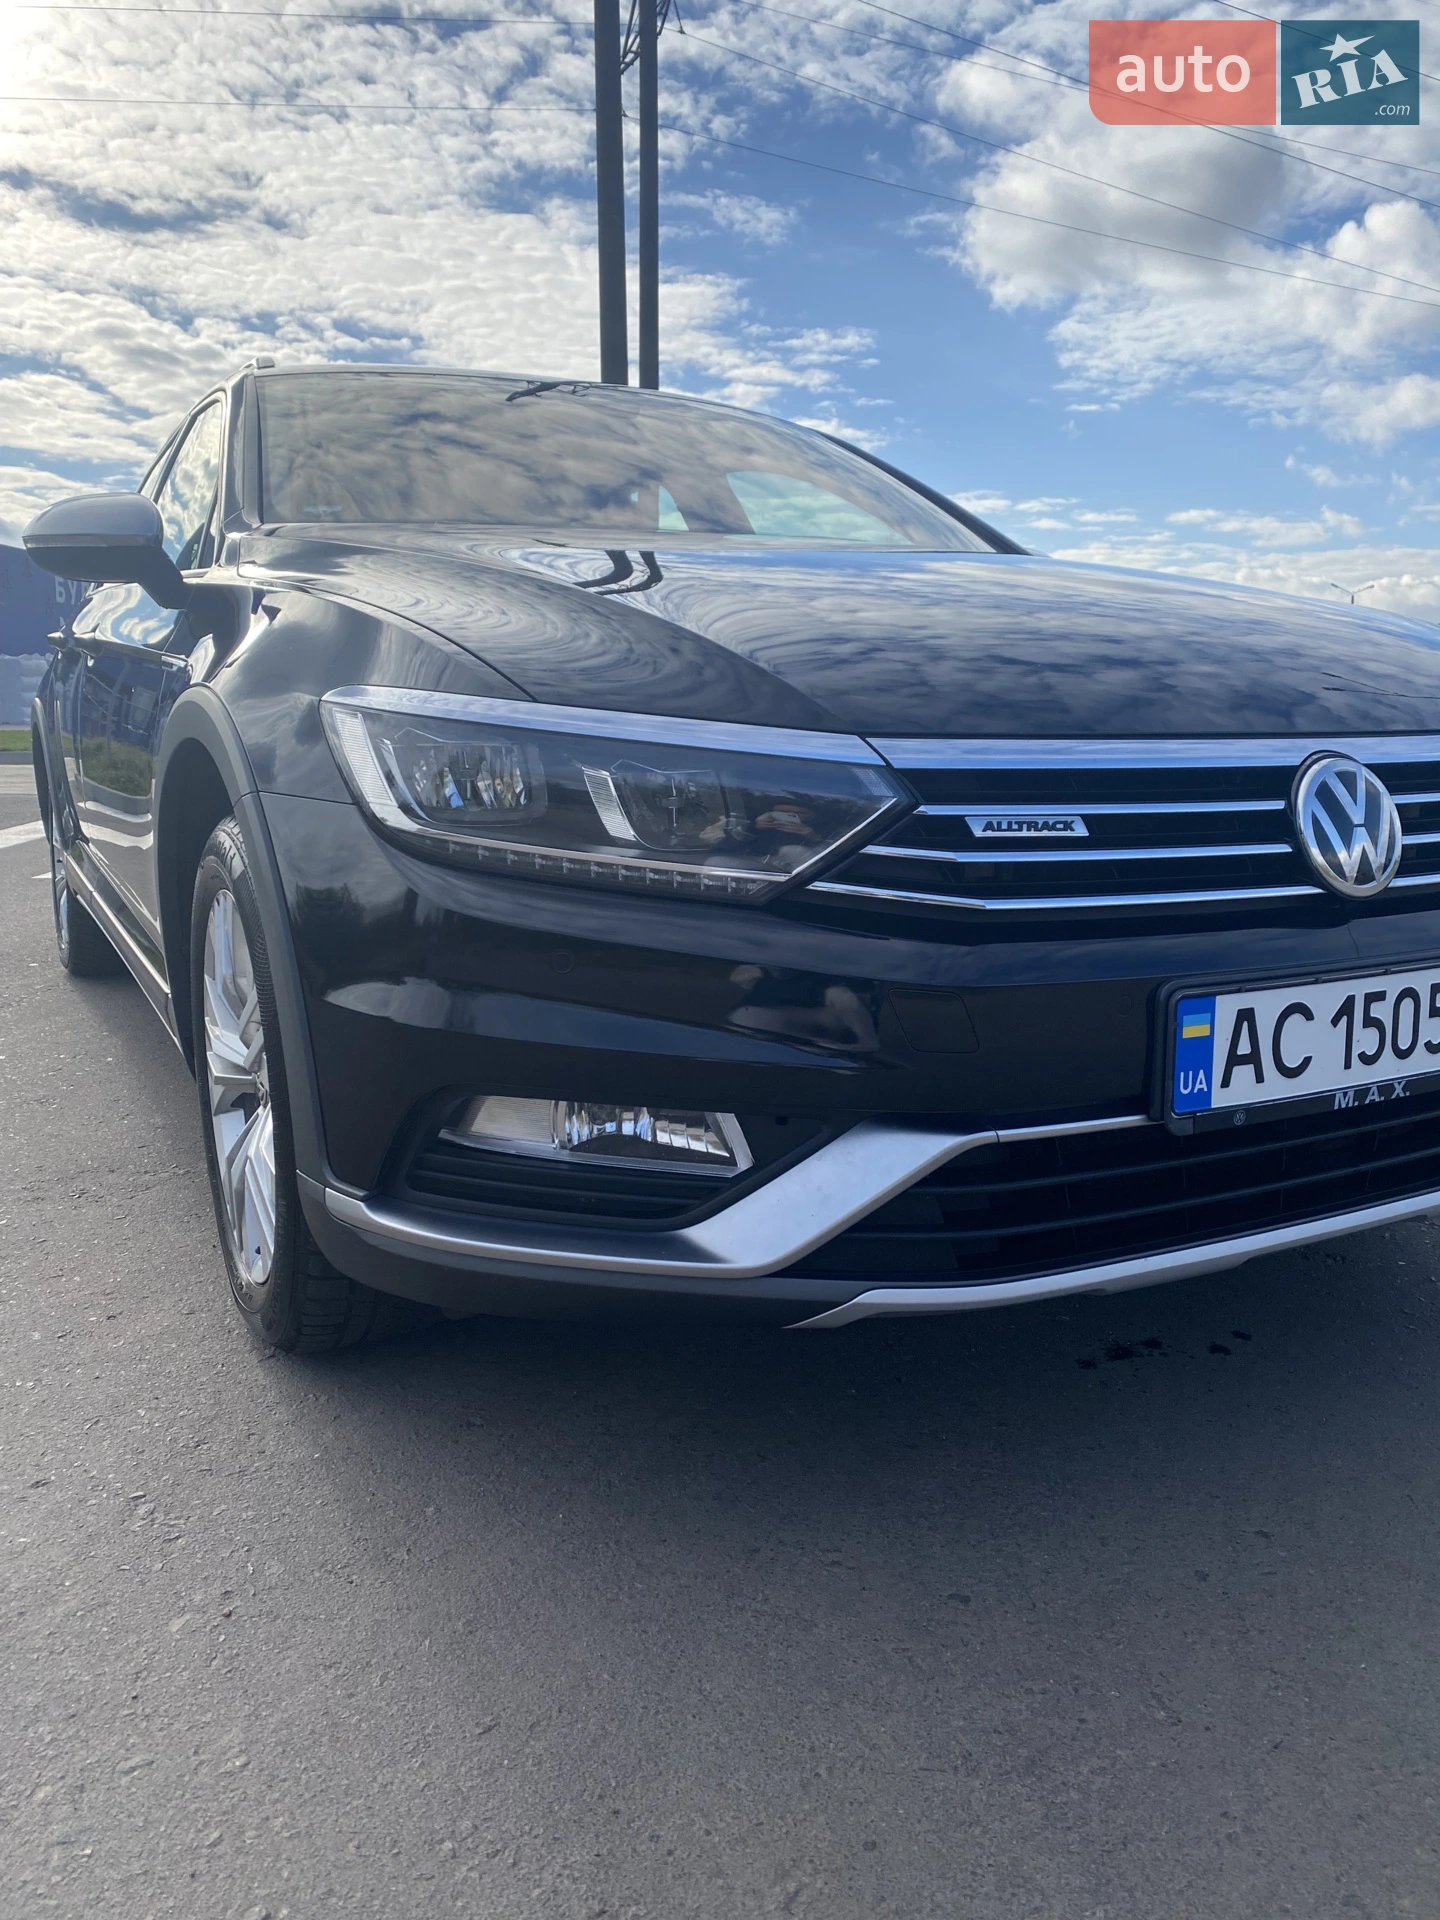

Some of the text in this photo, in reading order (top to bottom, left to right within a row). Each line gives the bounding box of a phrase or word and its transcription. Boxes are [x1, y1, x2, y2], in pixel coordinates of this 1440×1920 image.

[981, 820, 1076, 833] ALLTRACK
[1219, 982, 1440, 1089] AC 1505
[1179, 1069, 1208, 1095] UA
